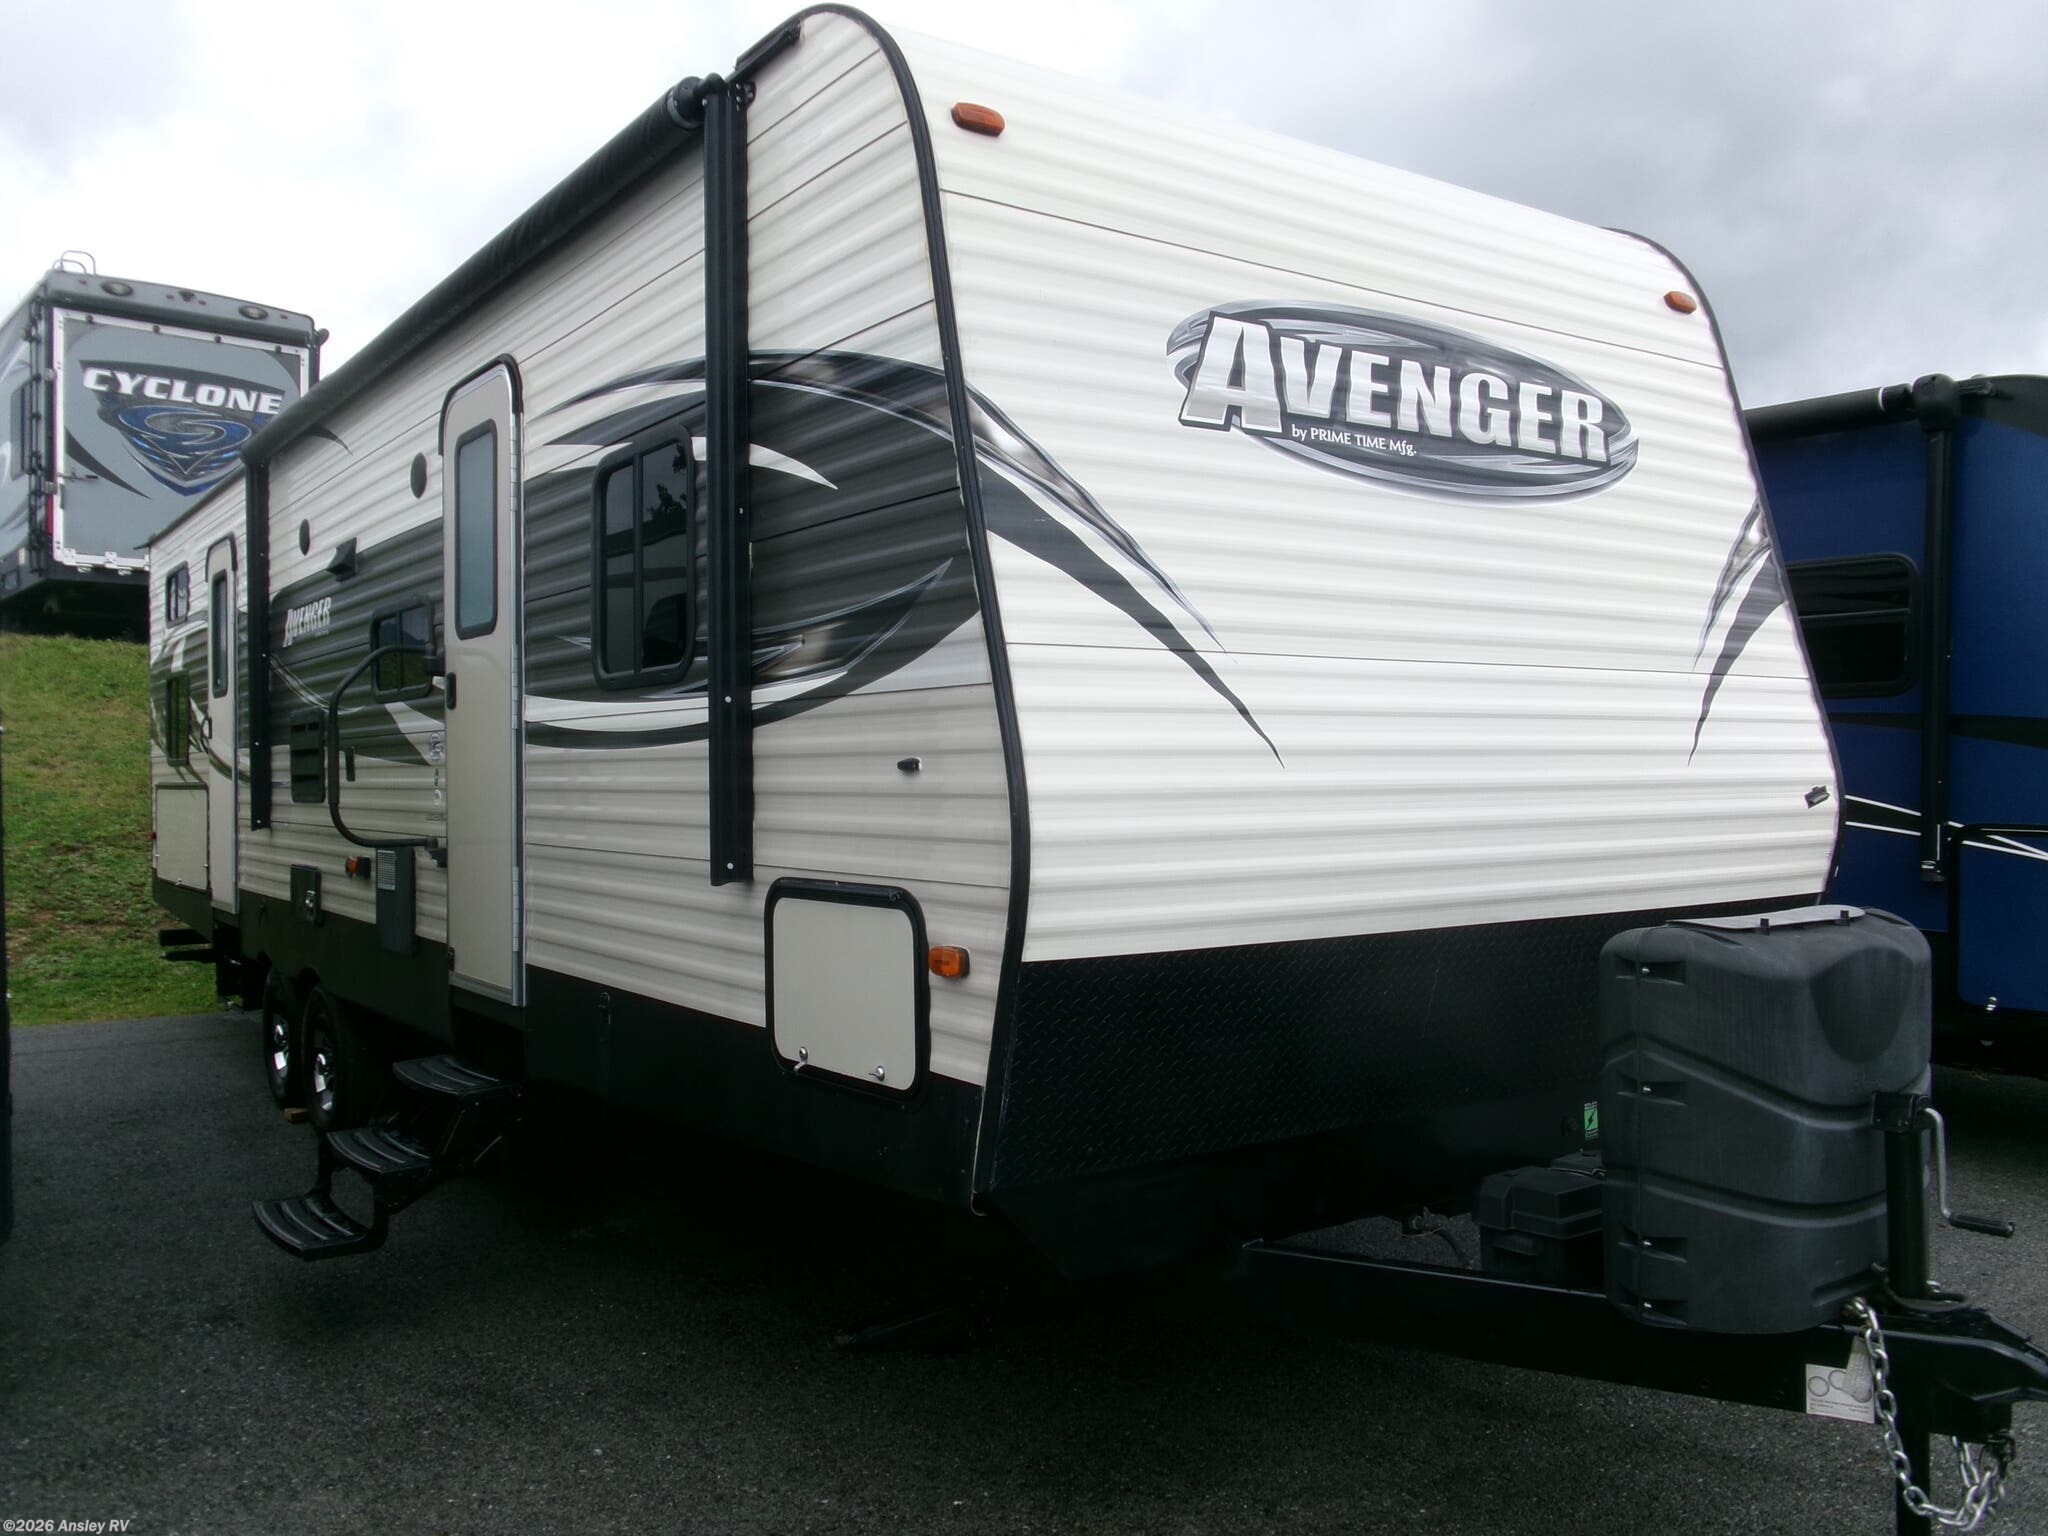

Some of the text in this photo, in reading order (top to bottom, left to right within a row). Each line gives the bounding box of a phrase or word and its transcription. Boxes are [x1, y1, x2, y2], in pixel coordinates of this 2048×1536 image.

[82, 367, 284, 415] CYCLONE
[1180, 313, 1610, 464] AVENGER
[1291, 423, 1417, 457] by PRIME TIME Mfg.
[282, 597, 332, 648] AVENGER
